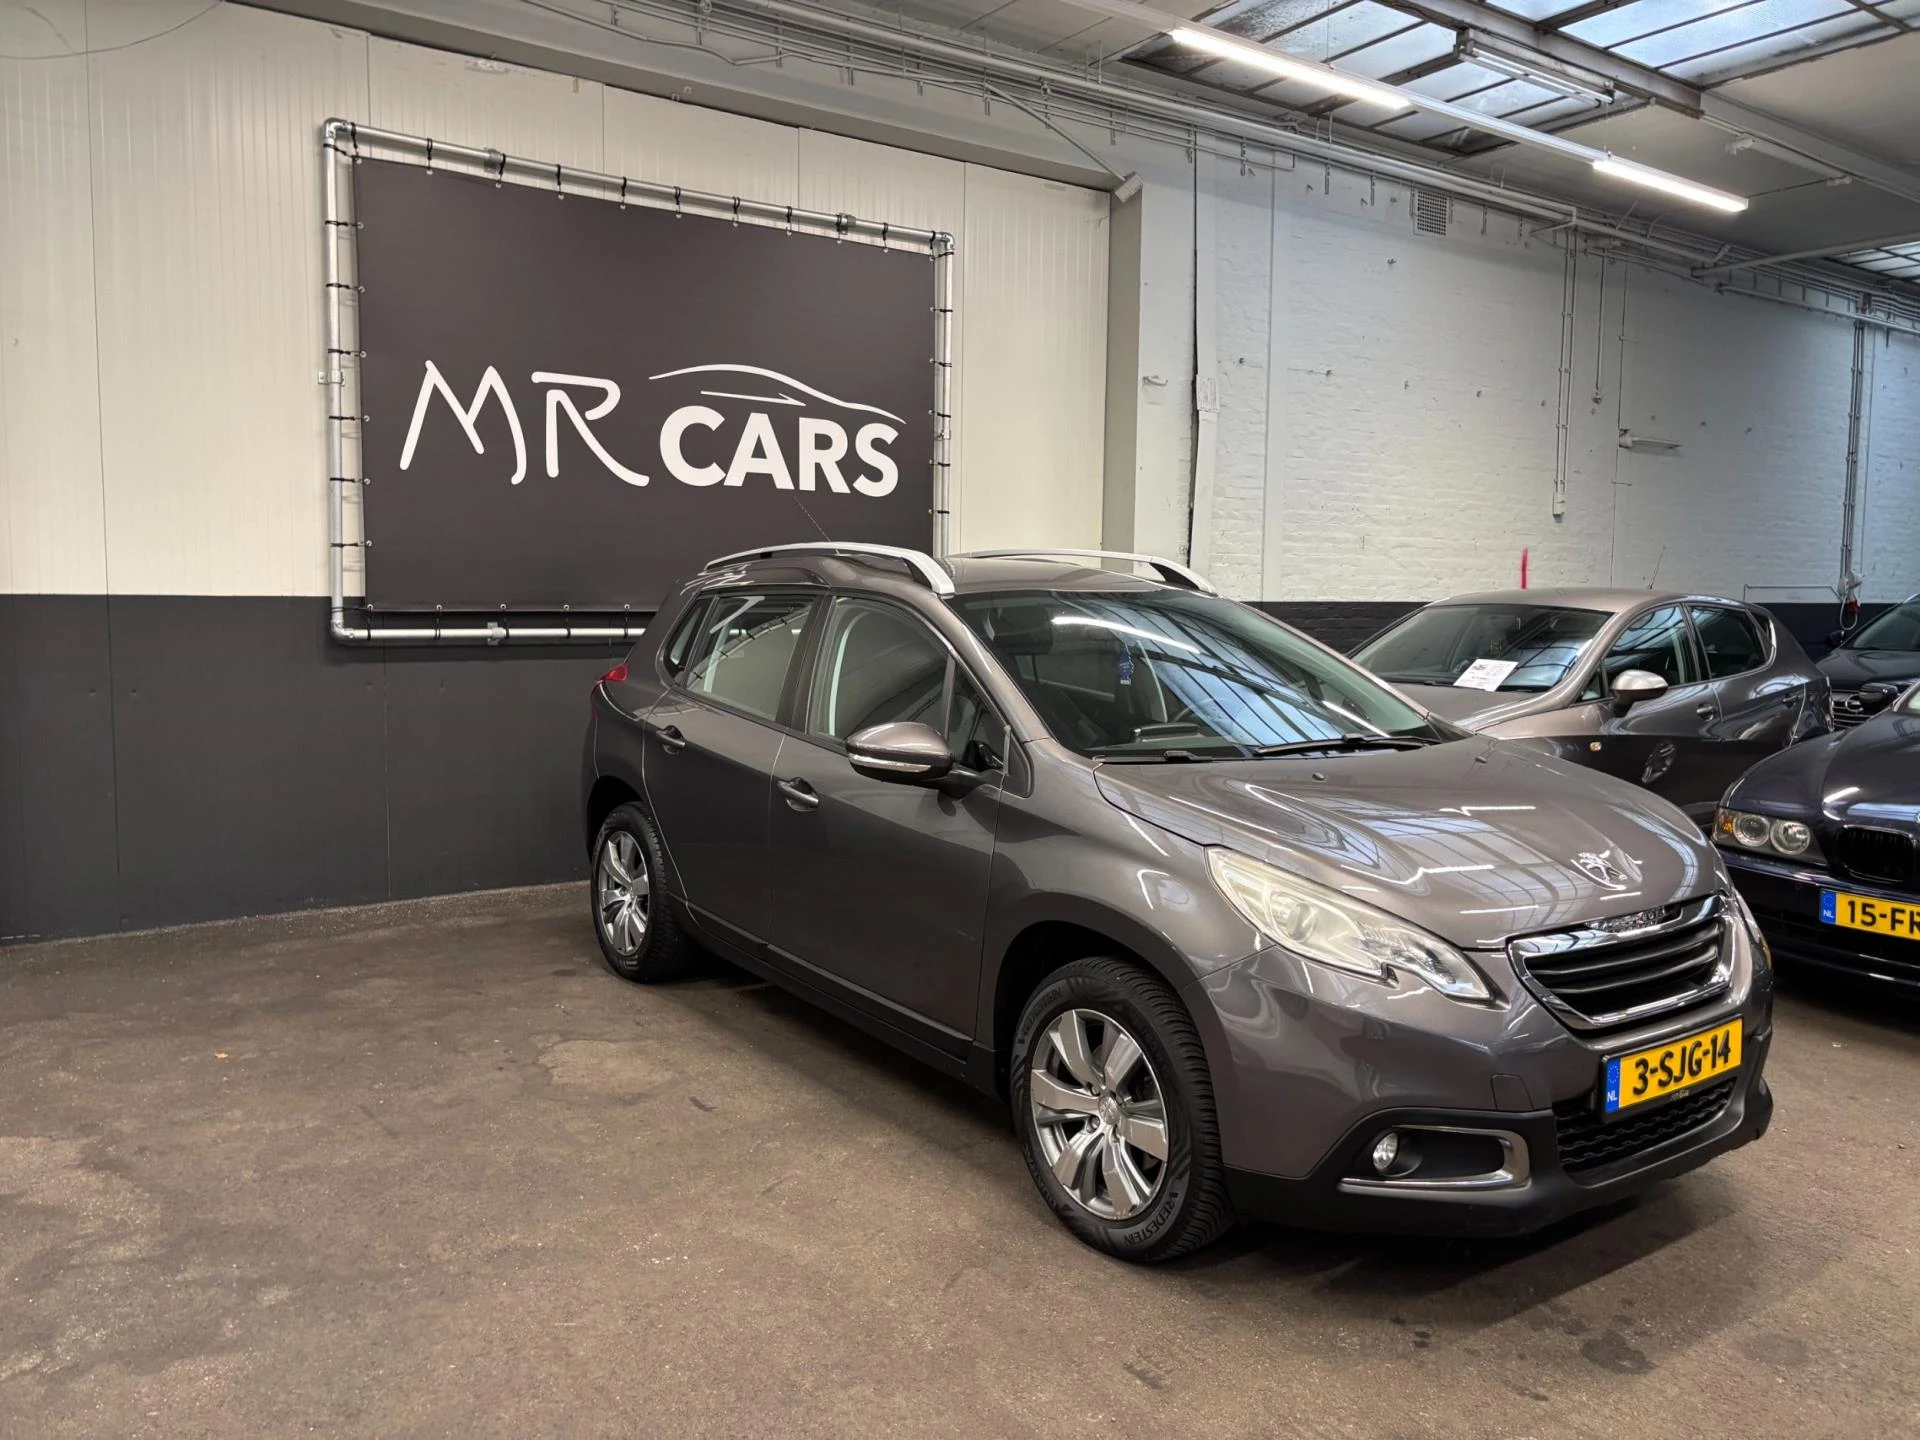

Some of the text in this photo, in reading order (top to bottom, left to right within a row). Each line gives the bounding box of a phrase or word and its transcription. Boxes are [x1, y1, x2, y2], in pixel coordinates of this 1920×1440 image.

[400, 360, 899, 497] MR CARS
[1823, 909, 1834, 919] NL
[1633, 1029, 1731, 1097] 3-SJG-14
[1607, 1090, 1618, 1102] NL
